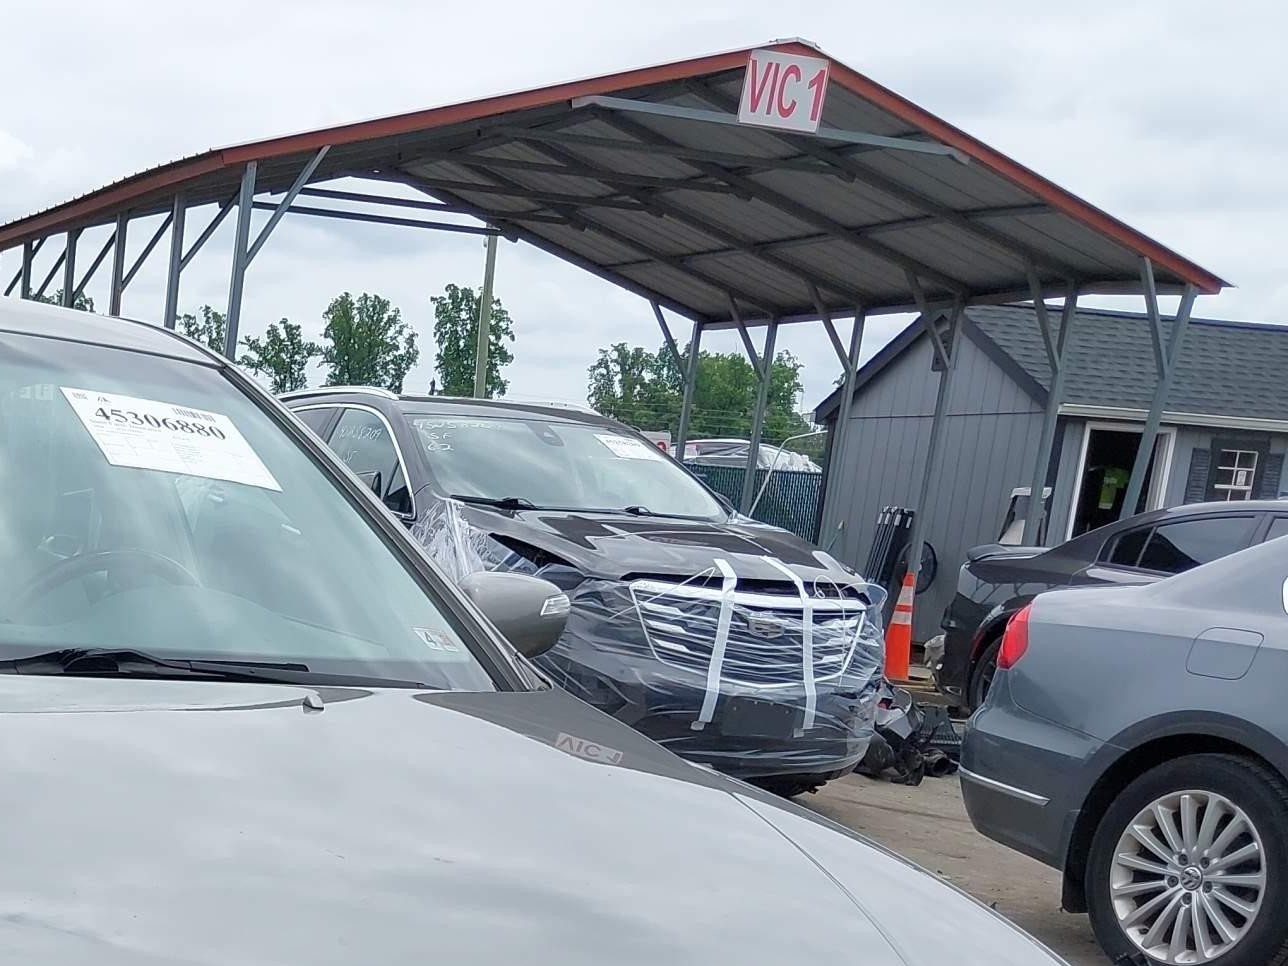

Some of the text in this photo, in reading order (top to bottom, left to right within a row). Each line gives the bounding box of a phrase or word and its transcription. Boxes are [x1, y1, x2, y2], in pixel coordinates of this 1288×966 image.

[750, 59, 827, 122] VIC 1
[94, 406, 227, 441] 45306880
